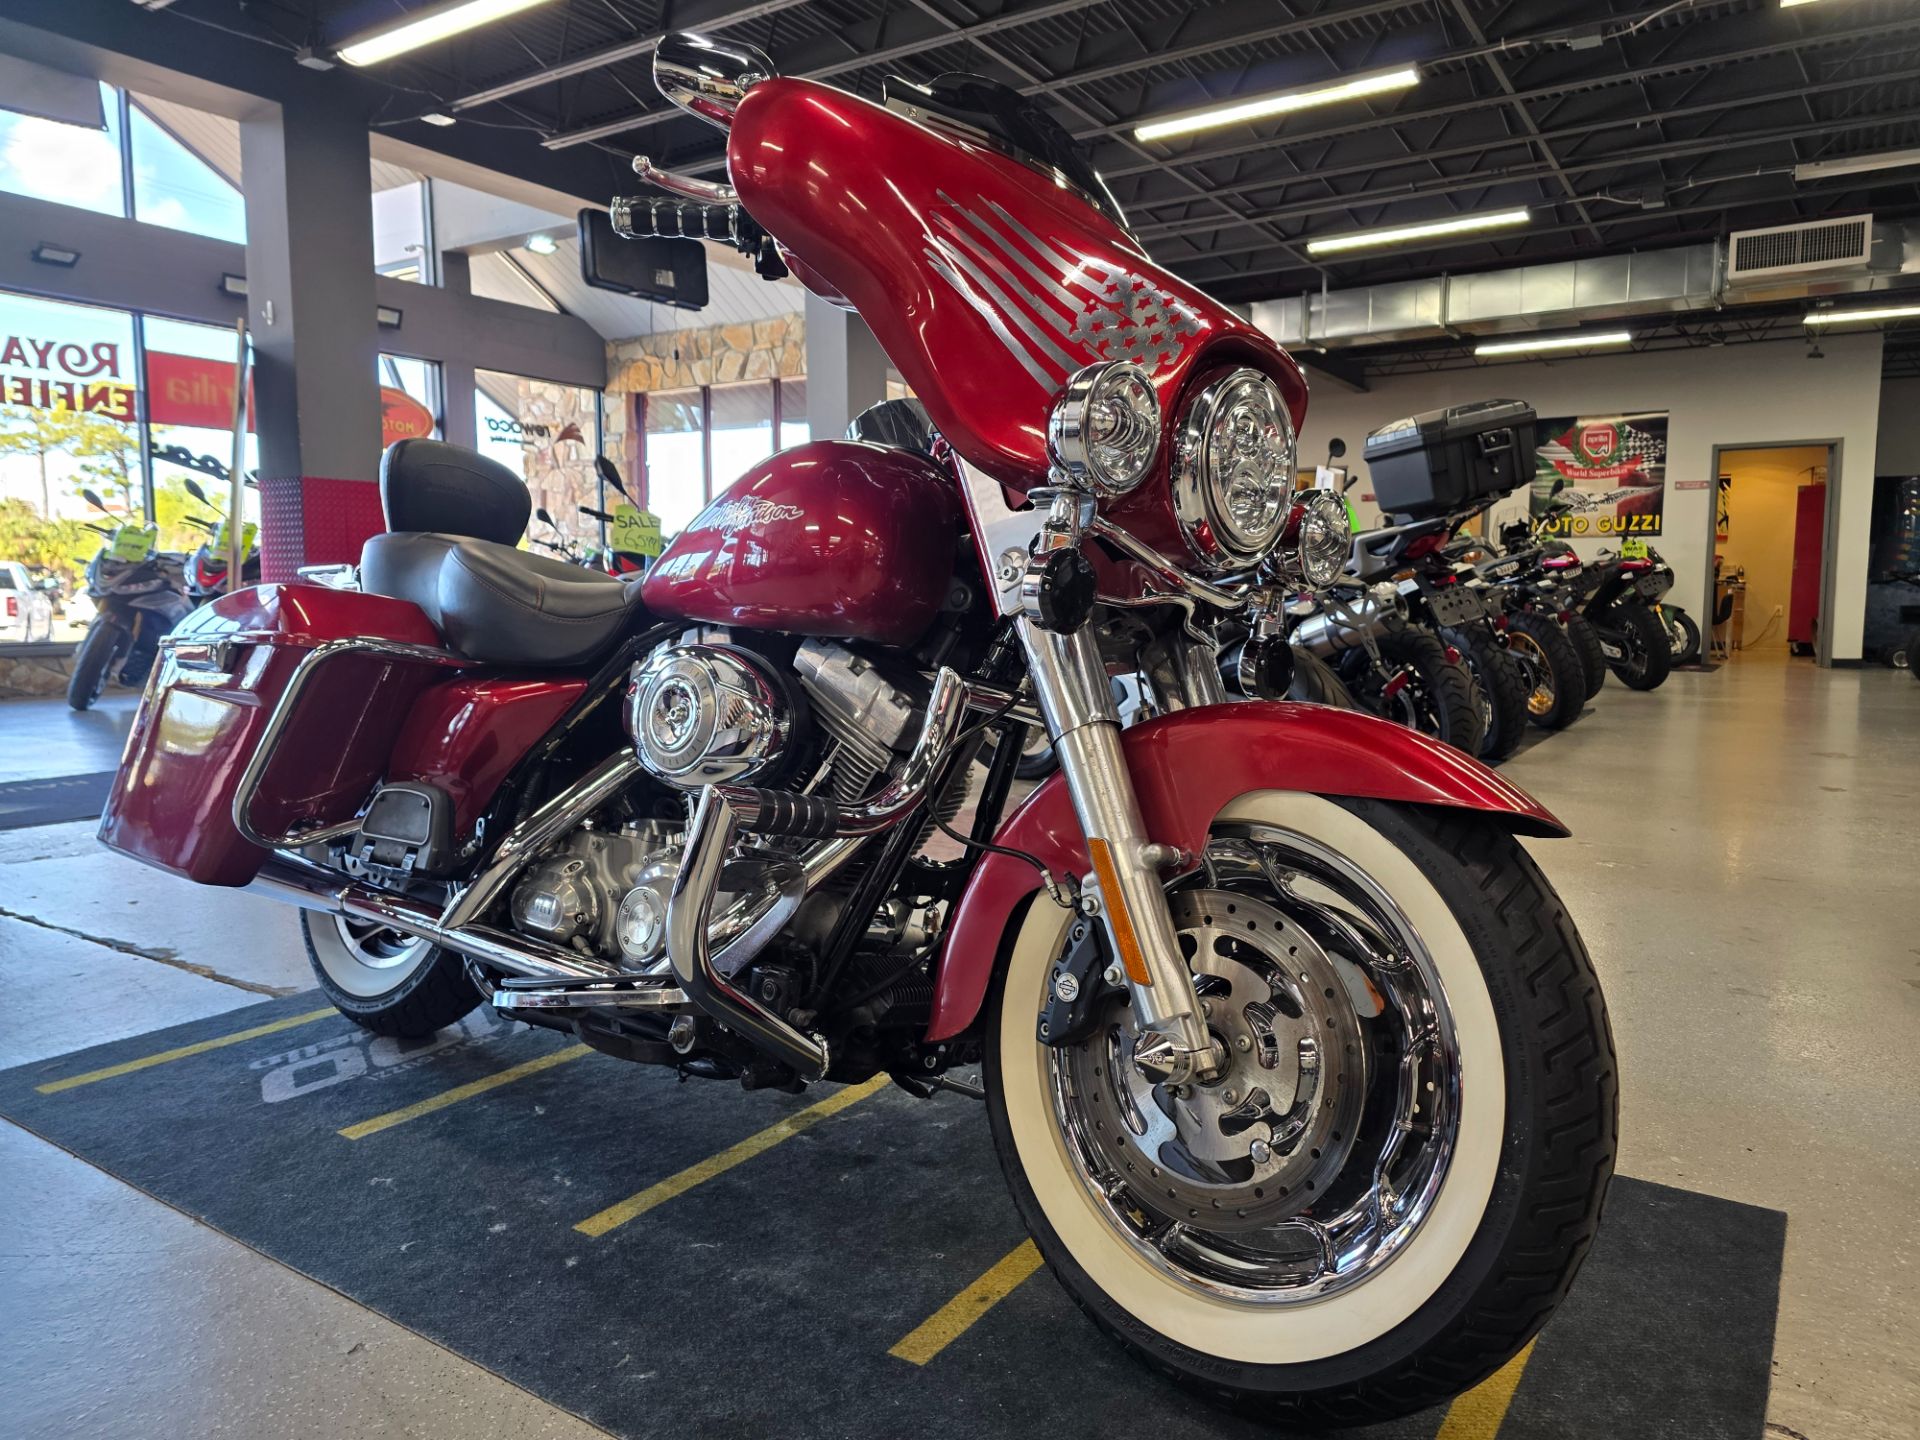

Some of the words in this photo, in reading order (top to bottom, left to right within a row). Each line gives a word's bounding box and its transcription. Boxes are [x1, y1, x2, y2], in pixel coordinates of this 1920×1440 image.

[1566, 469, 1587, 478] World
[616, 514, 660, 528] SALE
[1596, 514, 1660, 533] GUZZI
